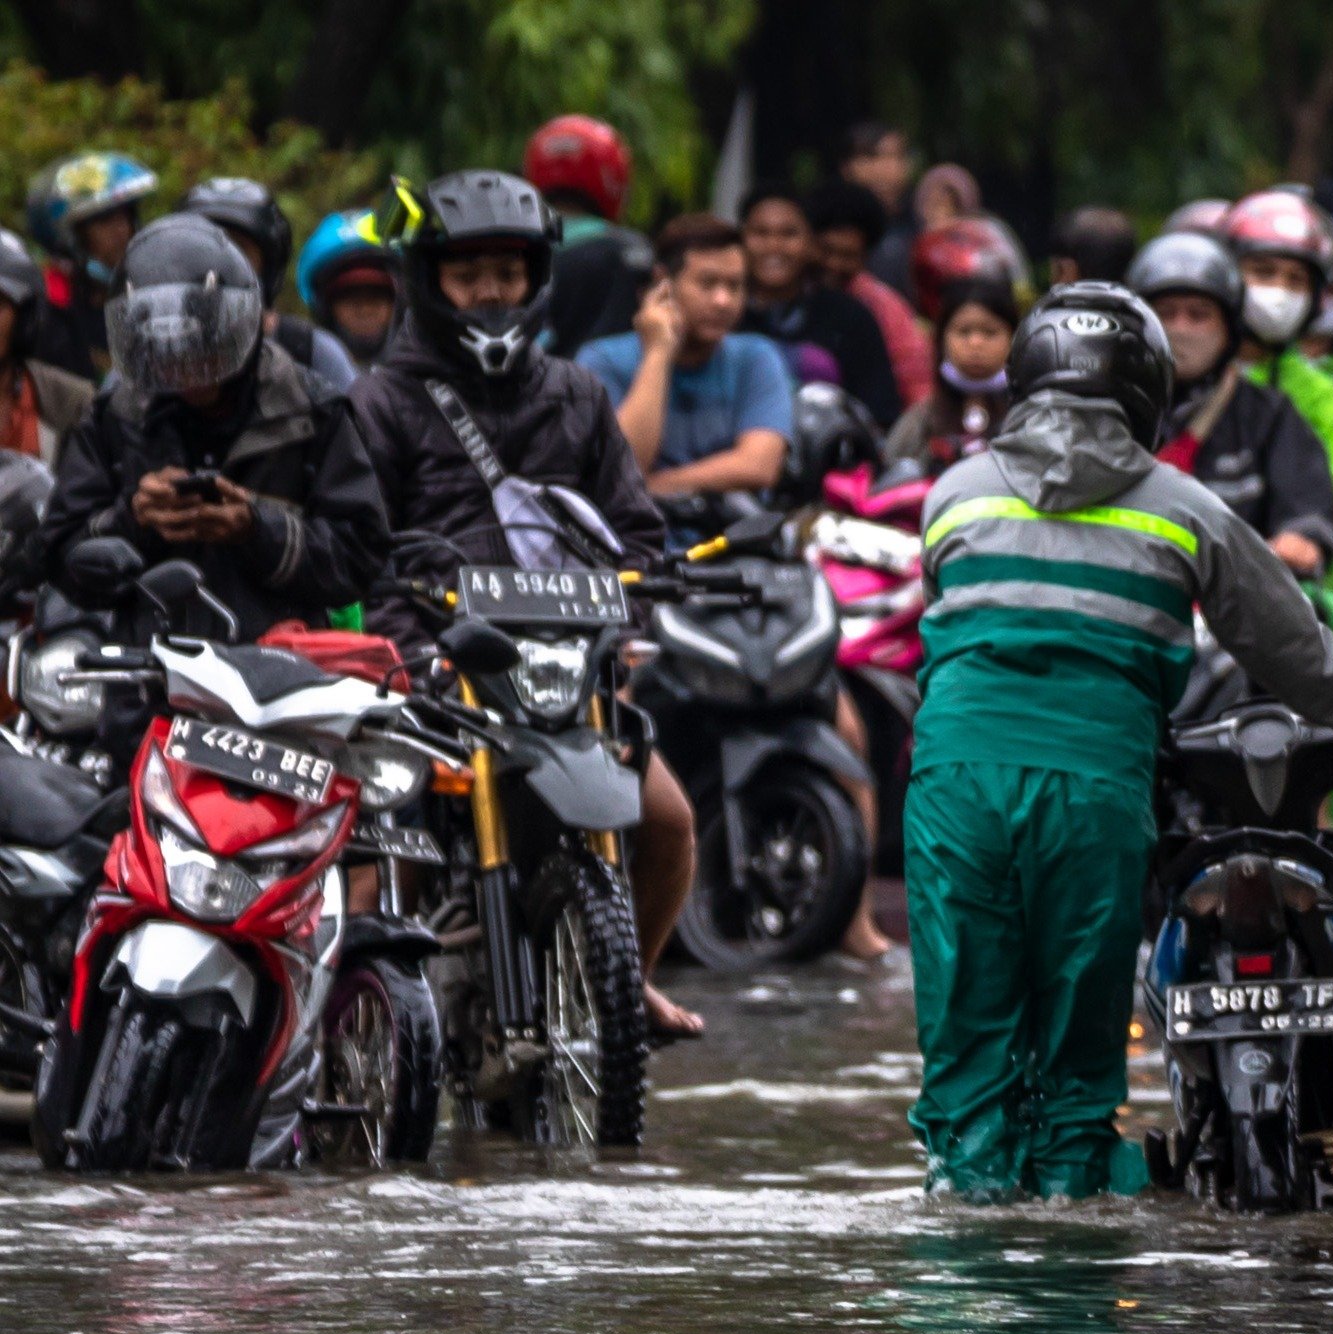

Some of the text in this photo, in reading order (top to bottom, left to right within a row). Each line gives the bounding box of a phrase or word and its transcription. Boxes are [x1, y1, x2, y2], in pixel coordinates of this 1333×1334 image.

[472, 572, 502, 600] AA
[514, 572, 575, 596] 5940
[173, 718, 328, 783] H 4423 BEE
[1174, 990, 1191, 1016] H
[1210, 985, 1281, 1012] 5878
